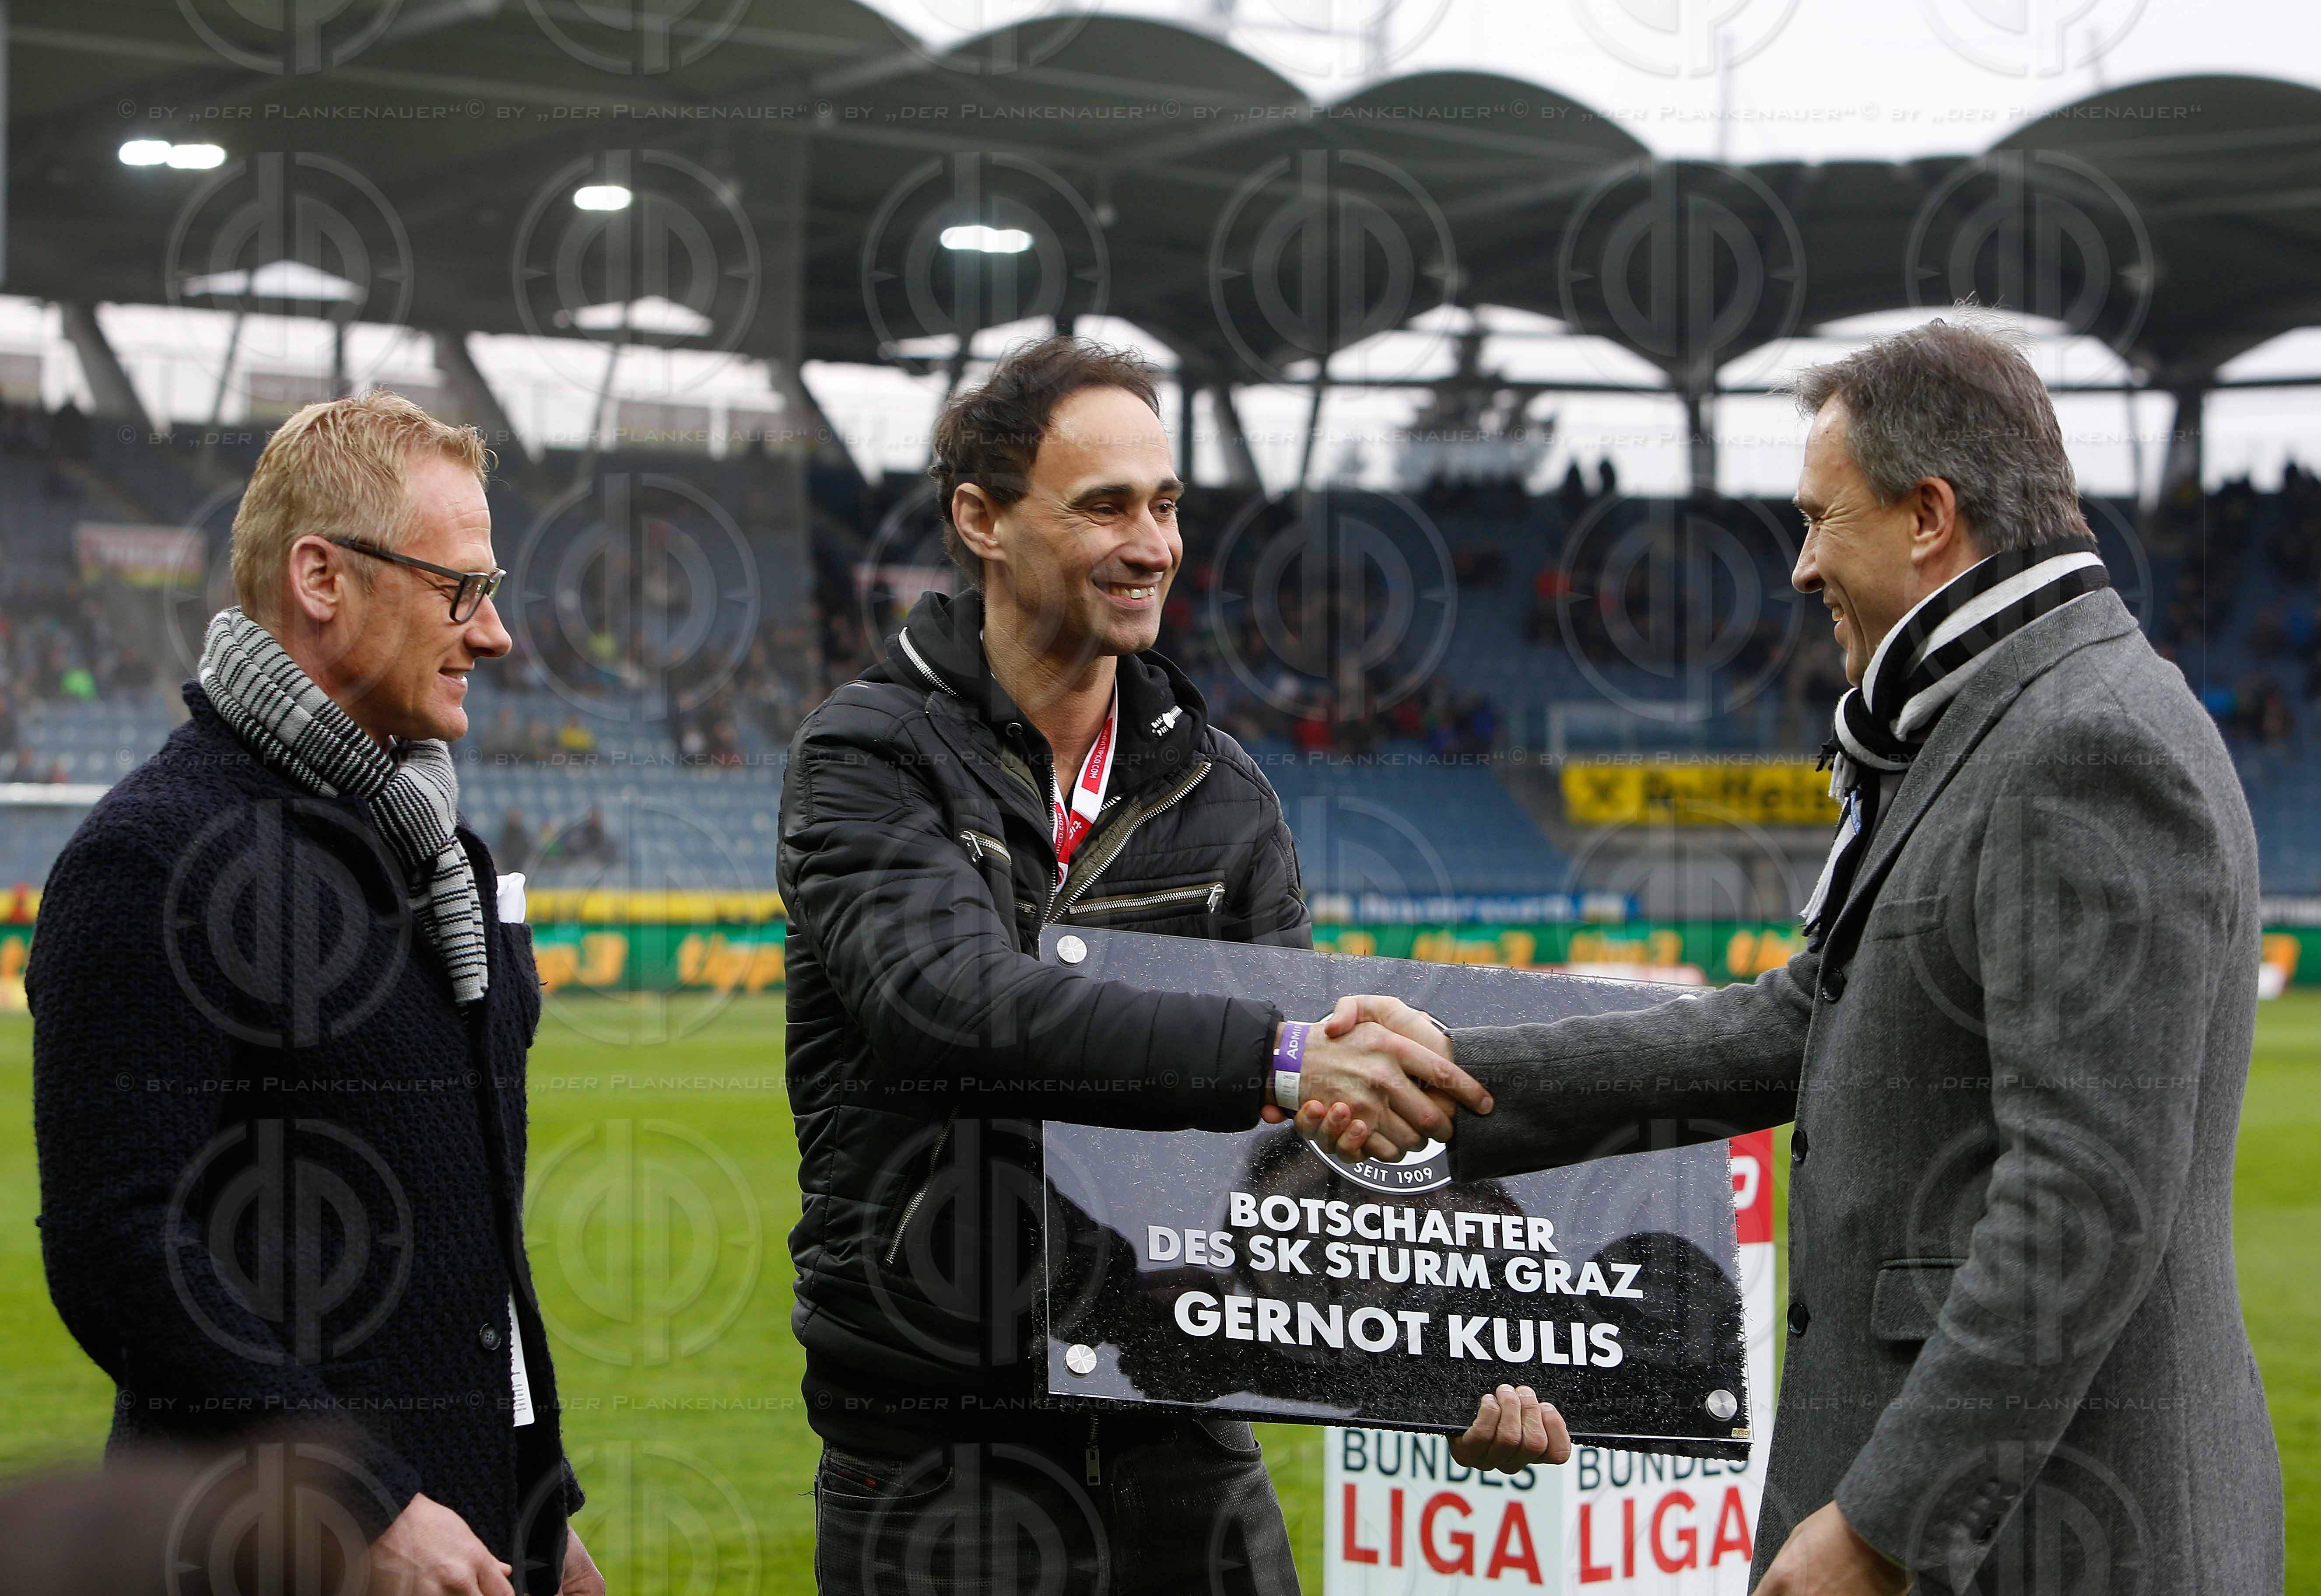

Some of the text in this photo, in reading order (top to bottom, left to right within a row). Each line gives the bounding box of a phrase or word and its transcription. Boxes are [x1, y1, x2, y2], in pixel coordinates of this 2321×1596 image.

[1353, 1161, 1433, 1184] SEIT 1909
[1230, 1191, 1559, 1253] BOTSCHAFTER
[1148, 1225, 1644, 1298] DES SK STURM GRAZ
[1174, 1291, 1624, 1368] GERNOT KULIS
[1343, 1483, 1543, 1585] LIGA
[1578, 1486, 1752, 1584] LIGA
